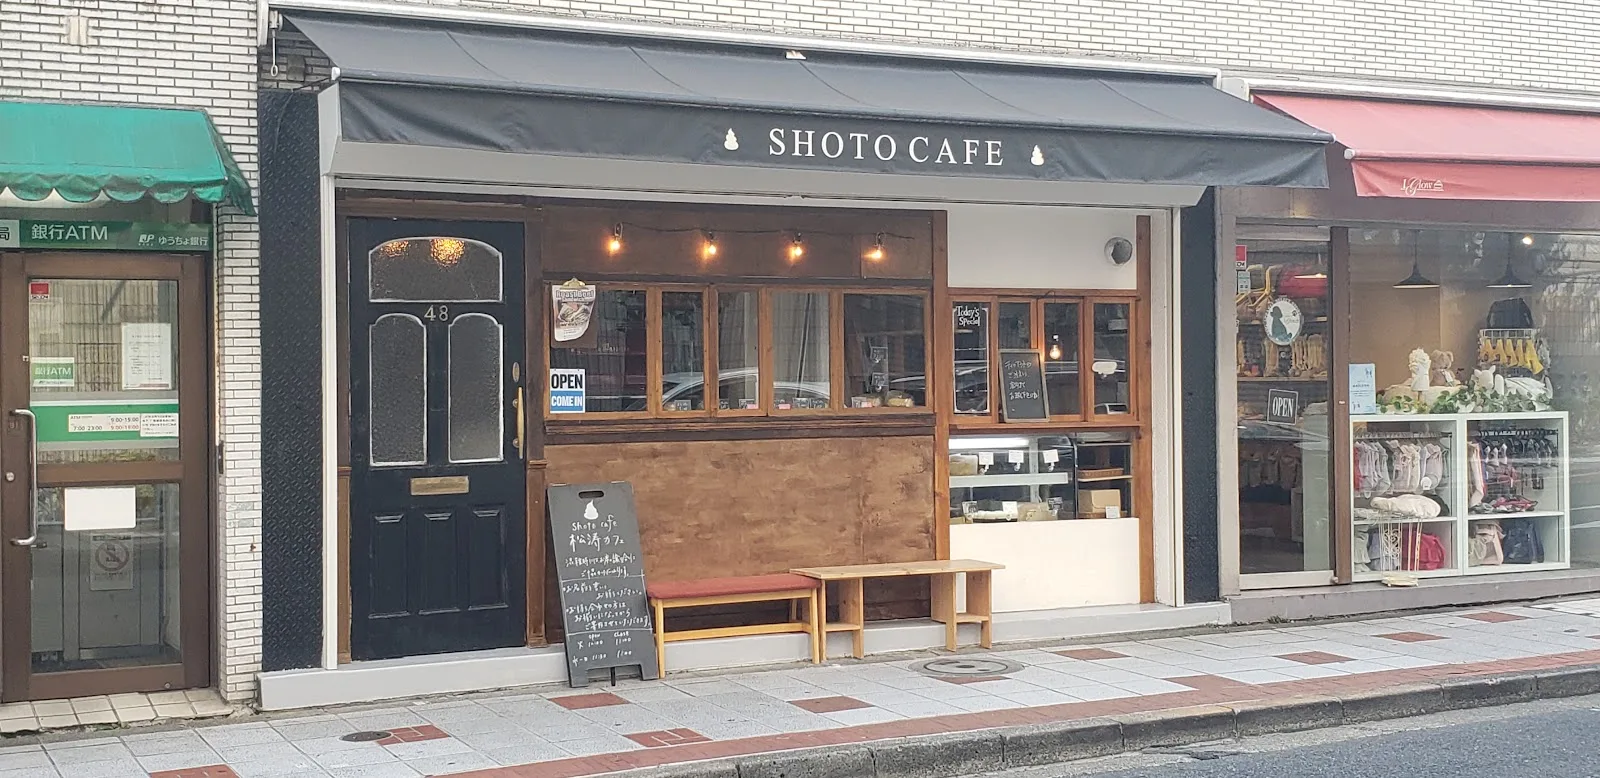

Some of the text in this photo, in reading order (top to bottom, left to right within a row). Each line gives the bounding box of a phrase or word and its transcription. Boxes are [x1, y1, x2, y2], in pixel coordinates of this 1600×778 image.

[768, 127, 1004, 166] SHOTO CAFE
[31, 223, 108, 240] 銀行ATM
[158, 236, 208, 246] ゆうちょ銀行
[424, 305, 449, 321] 48
[955, 305, 980, 318] Today's
[959, 317, 980, 327] Special
[551, 374, 583, 389] OPEN
[551, 395, 583, 407] COME IN
[1272, 396, 1294, 417] OPEN
